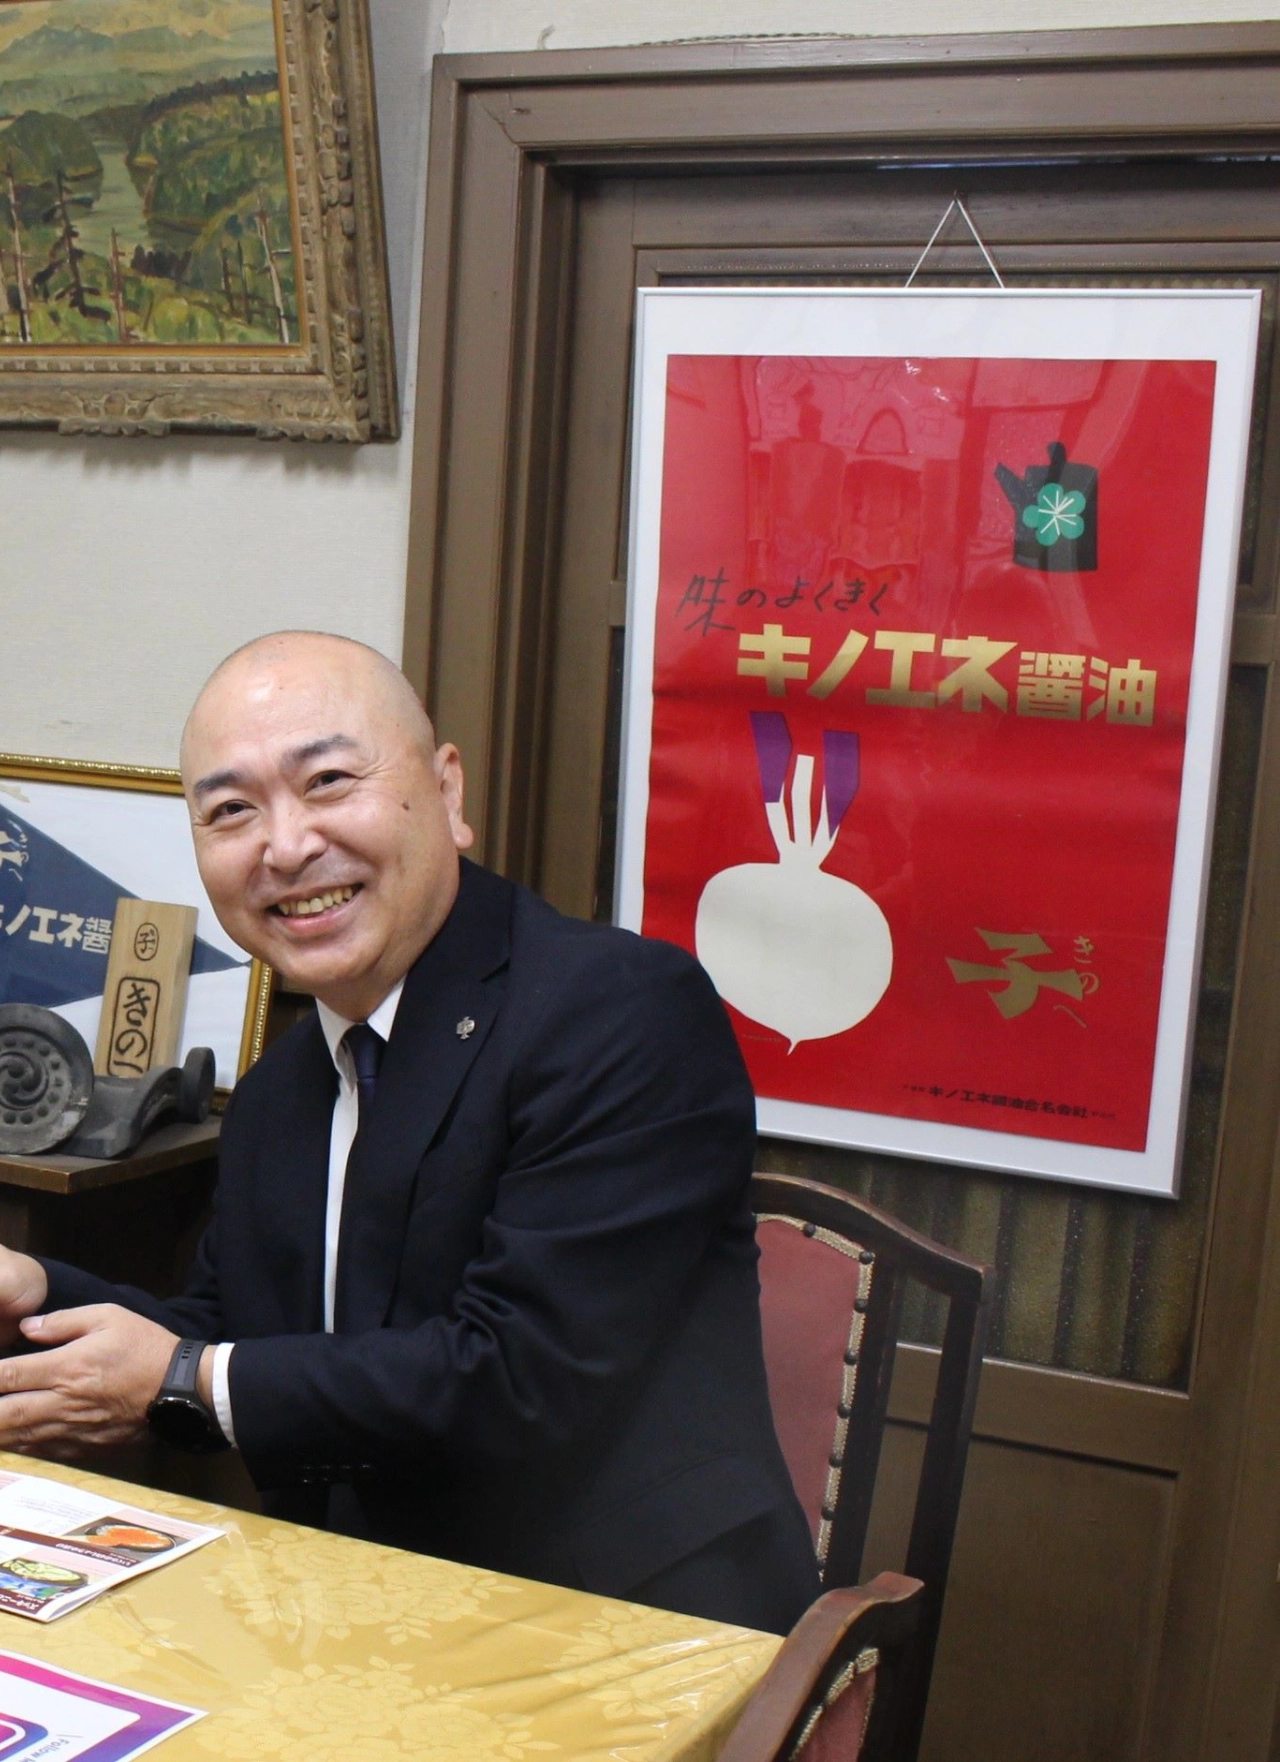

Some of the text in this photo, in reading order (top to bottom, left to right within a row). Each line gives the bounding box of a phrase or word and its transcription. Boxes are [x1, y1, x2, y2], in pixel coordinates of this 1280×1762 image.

[736, 623, 1158, 728] キノエネ醤油
